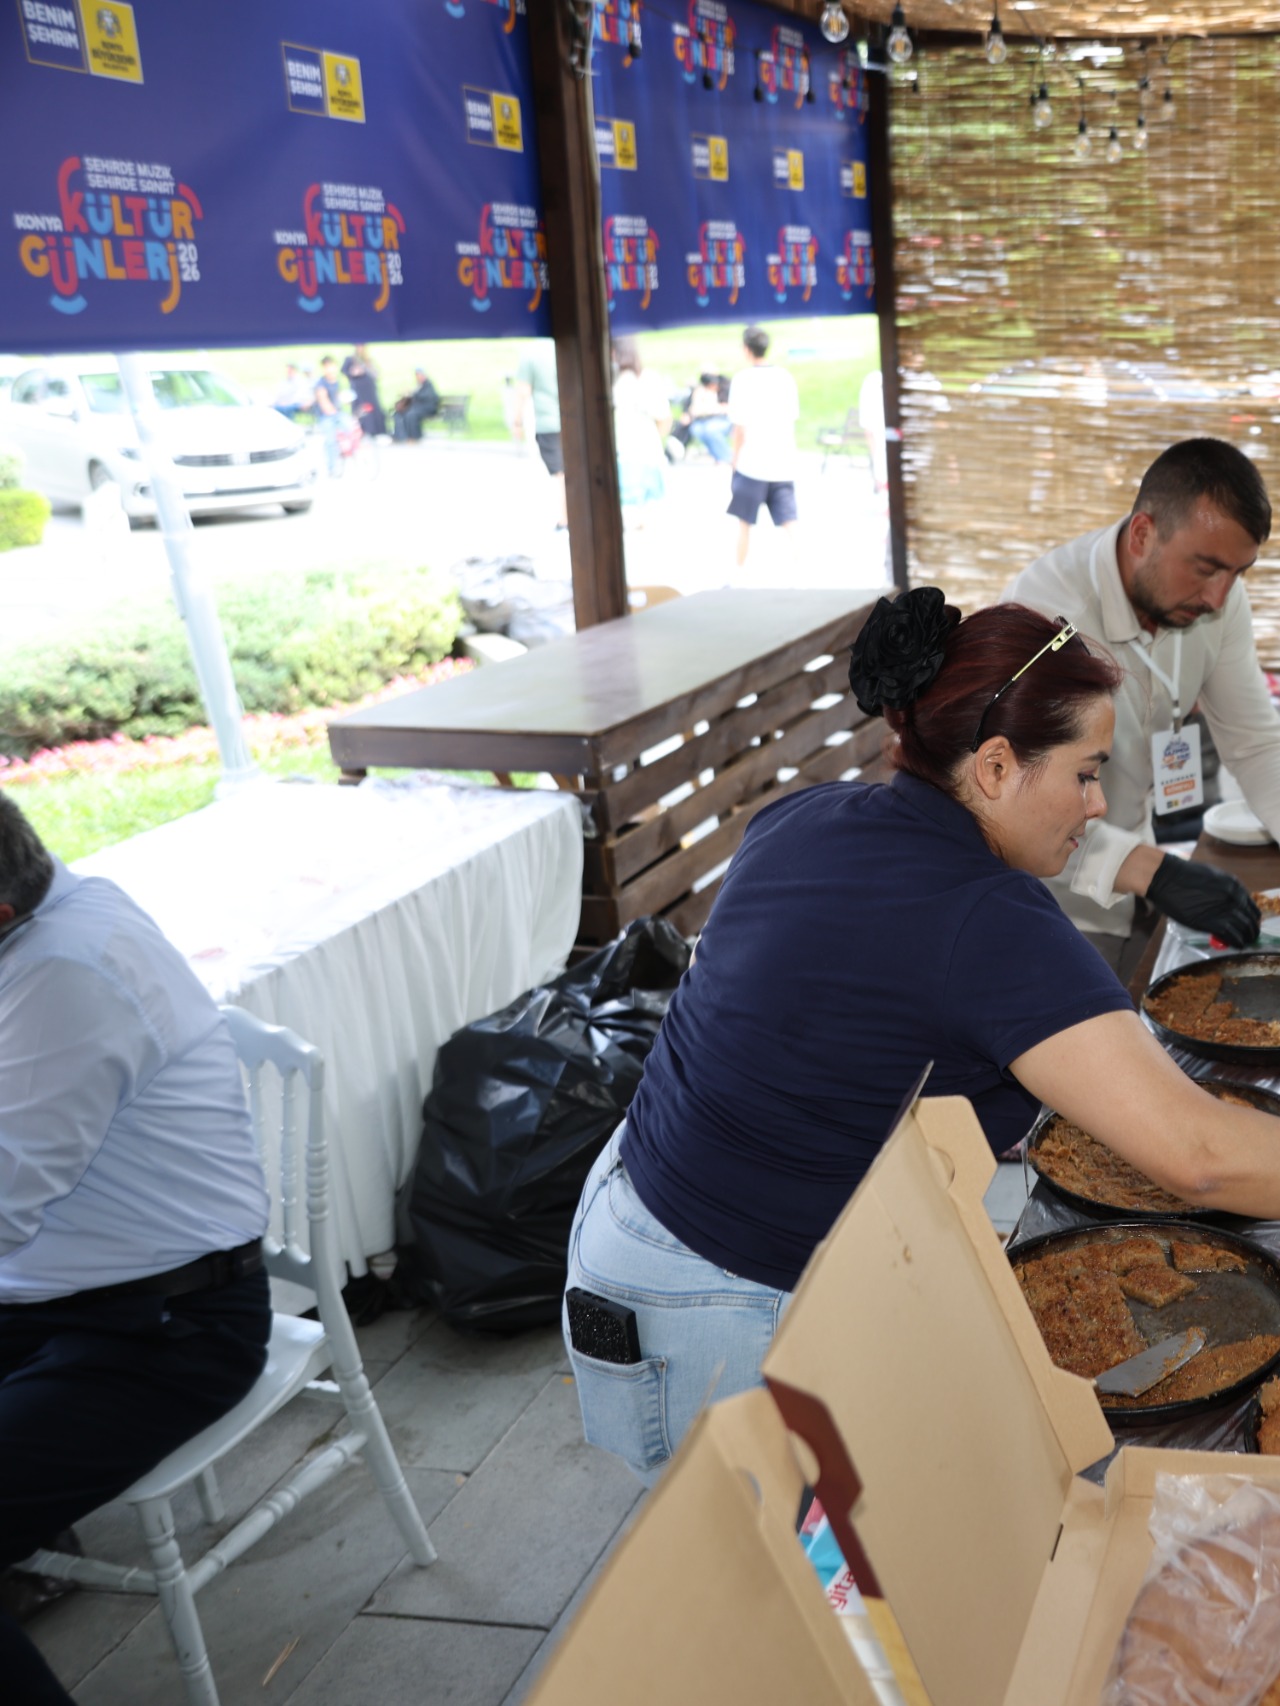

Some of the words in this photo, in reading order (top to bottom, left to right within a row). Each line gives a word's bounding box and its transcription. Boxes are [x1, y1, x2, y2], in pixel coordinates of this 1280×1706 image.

[14, 212, 63, 232] KONYA
[58, 157, 196, 240] KÜLTÜR
[304, 183, 400, 250] KÜLTÜR
[20, 234, 182, 314] GÜNLERİ
